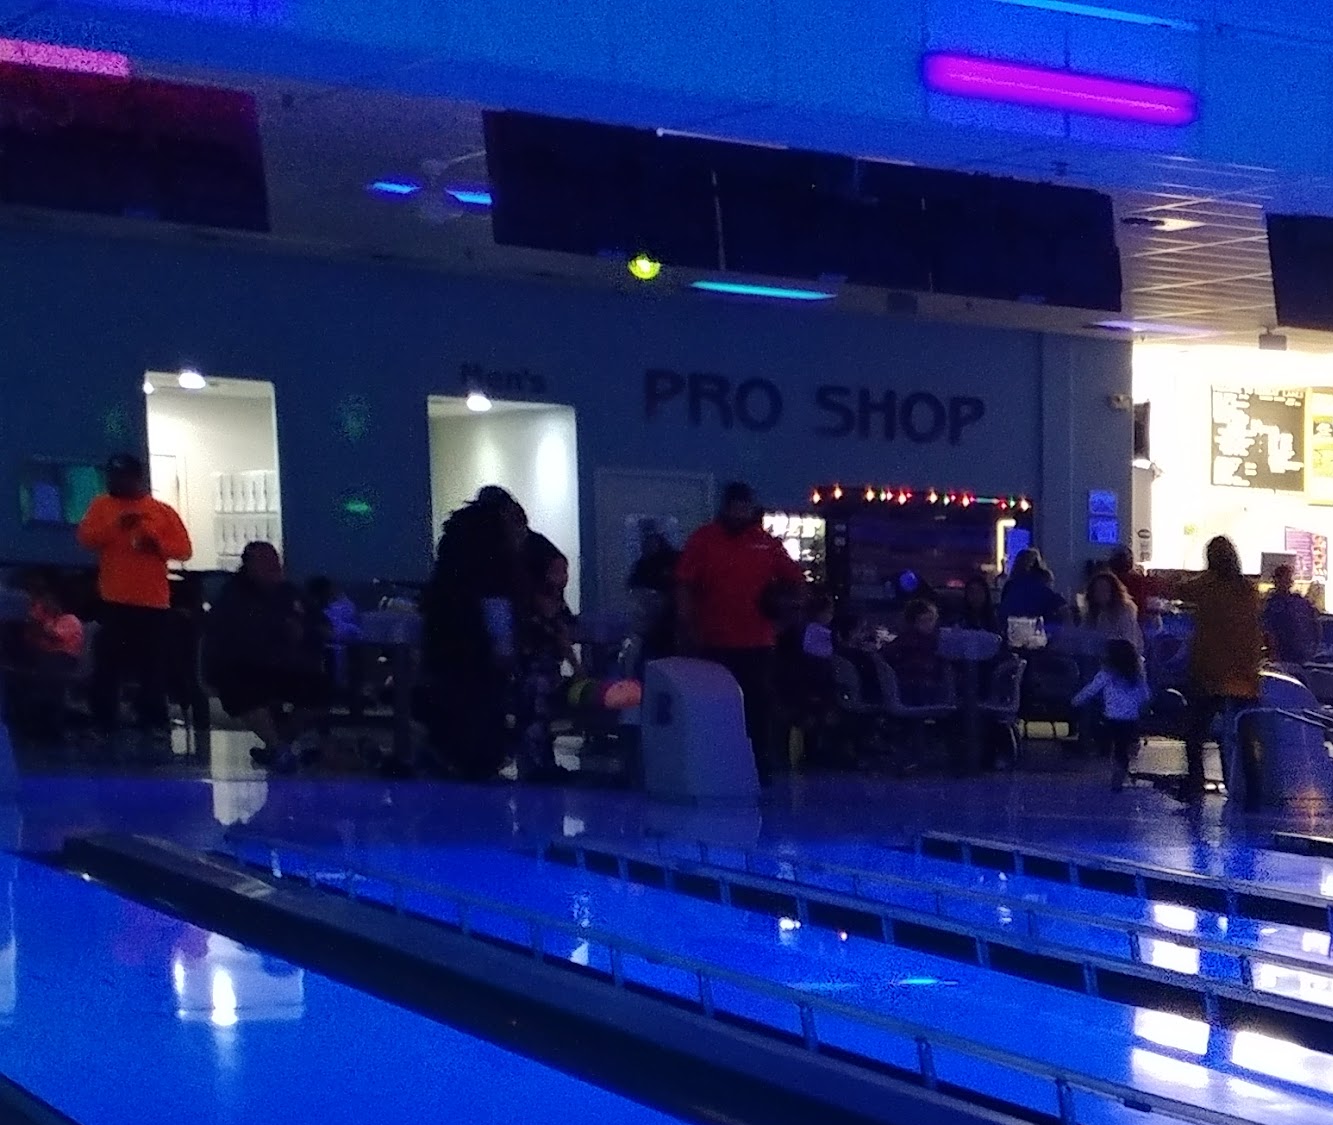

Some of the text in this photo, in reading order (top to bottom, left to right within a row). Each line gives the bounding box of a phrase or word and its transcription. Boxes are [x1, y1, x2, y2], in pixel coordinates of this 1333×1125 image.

[460, 361, 546, 394] Men's
[643, 367, 986, 446] PRO SHOP
